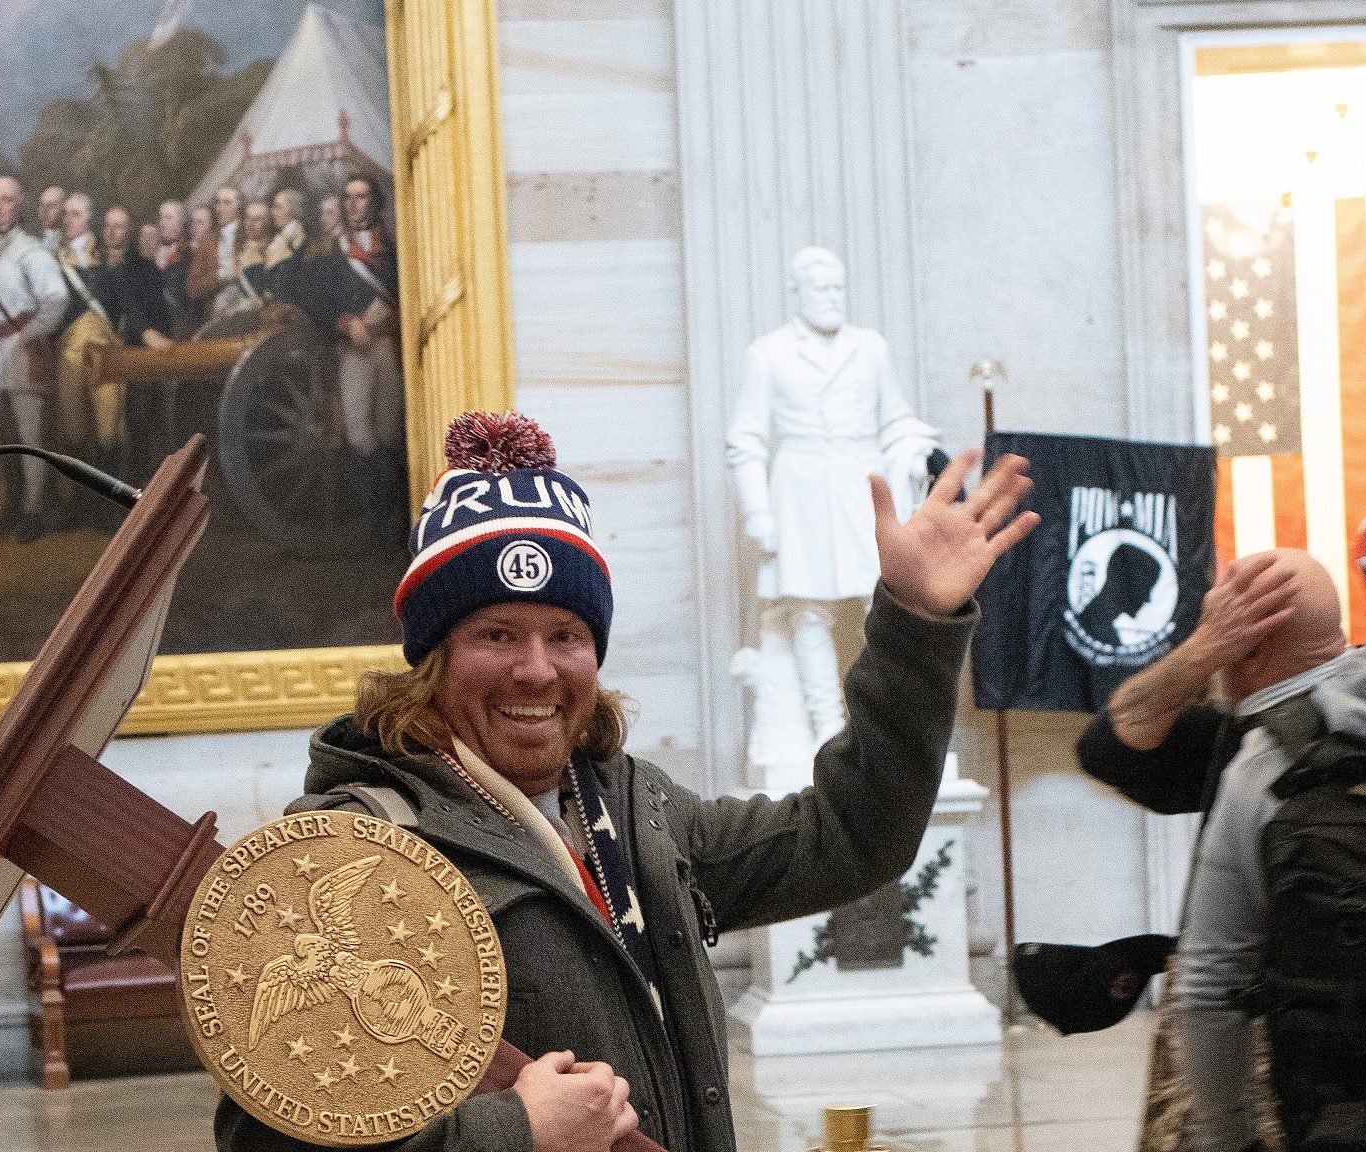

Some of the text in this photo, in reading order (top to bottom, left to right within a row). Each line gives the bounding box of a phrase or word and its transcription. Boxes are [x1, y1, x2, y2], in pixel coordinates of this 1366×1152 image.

[508, 553, 540, 580] 45
[188, 815, 337, 1039] SEAL OF THE SPEAKER
[219, 817, 503, 1138] UNITED STATES HOUSE OF REPRESENTATIVES
[234, 881, 277, 940] 1789
